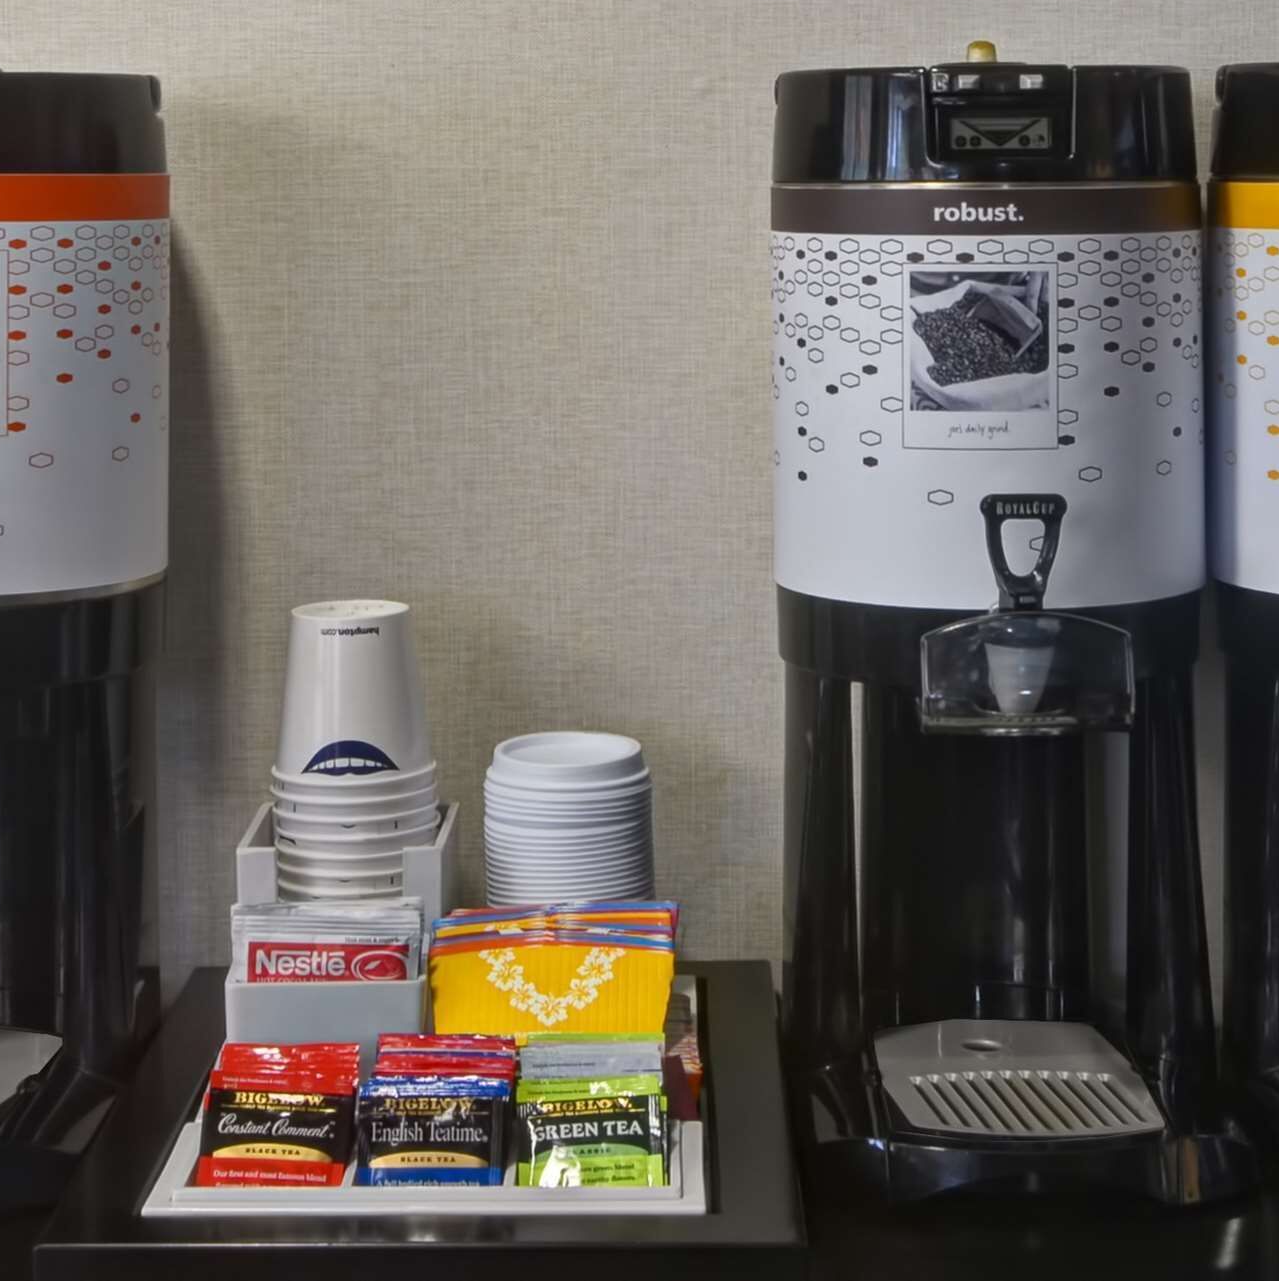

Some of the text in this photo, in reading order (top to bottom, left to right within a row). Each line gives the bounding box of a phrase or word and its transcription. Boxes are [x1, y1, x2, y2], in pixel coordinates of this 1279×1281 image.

[933, 201, 1024, 221] robust.
[383, 1097, 474, 1112] BIGELOW
[371, 1120, 424, 1147] English
[534, 1120, 644, 1142] GREEN TEA
